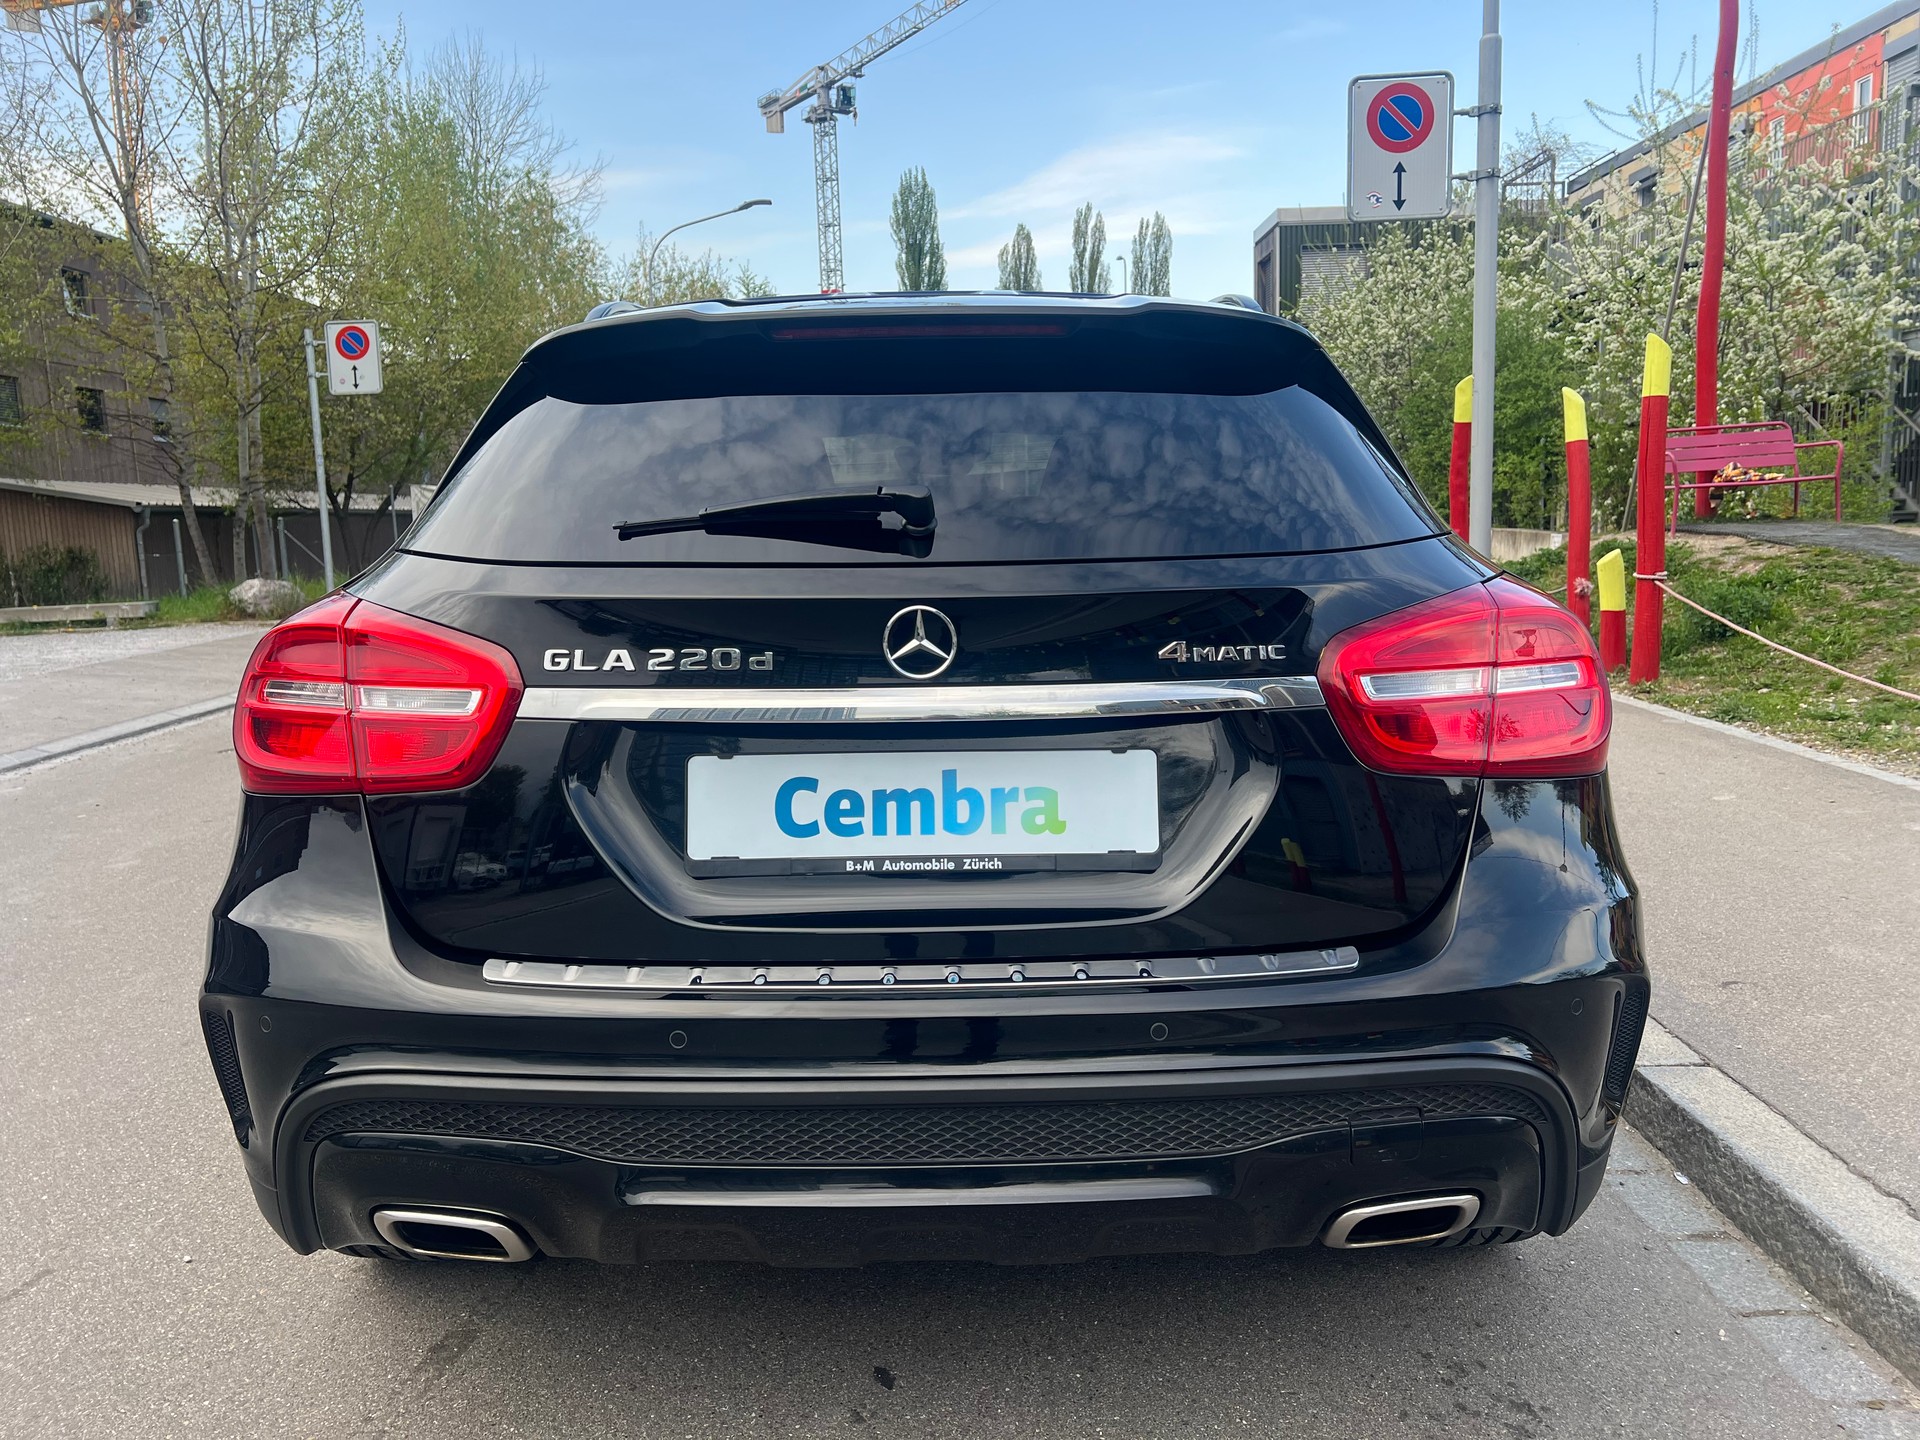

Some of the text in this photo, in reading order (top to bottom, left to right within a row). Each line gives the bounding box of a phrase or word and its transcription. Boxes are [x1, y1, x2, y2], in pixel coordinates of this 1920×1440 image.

[543, 648, 636, 671] GLA
[1157, 640, 1287, 663] 4MATIC
[774, 768, 1067, 839] Cembra
[845, 857, 1003, 871] B+M Automobile Zürich
